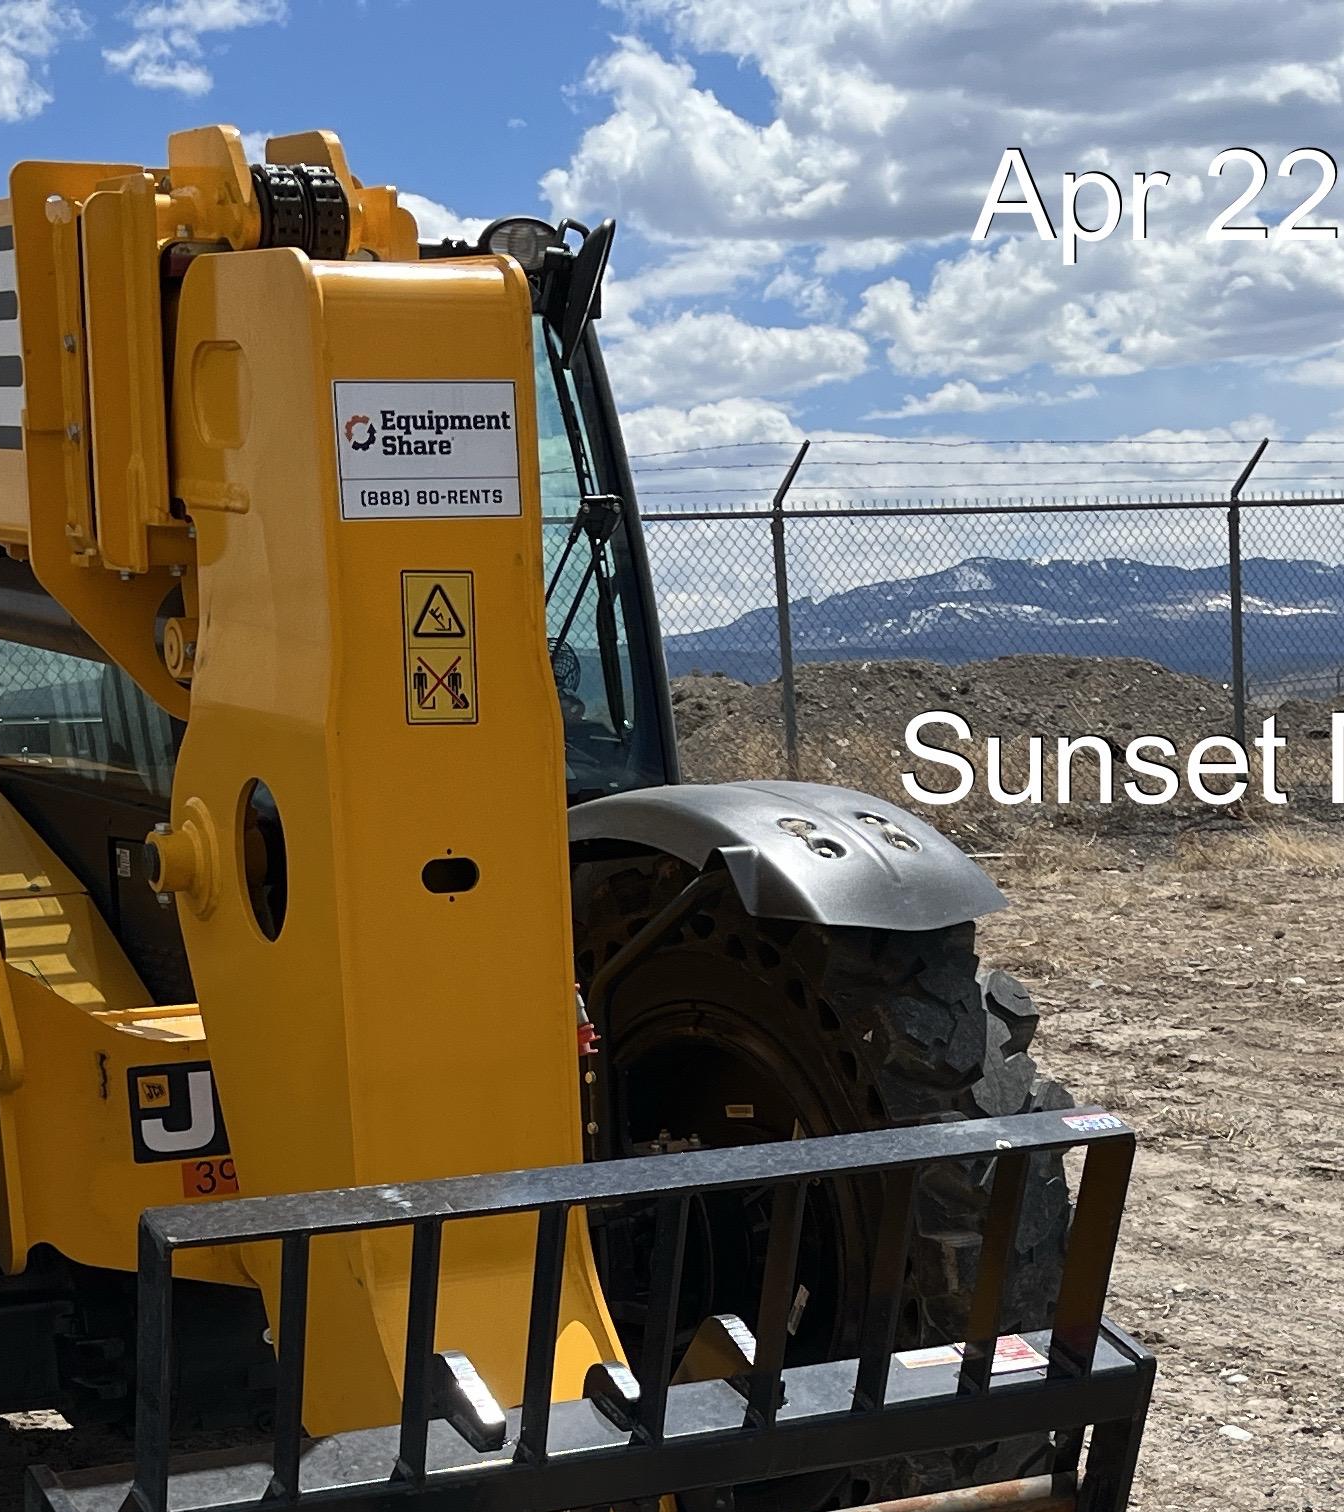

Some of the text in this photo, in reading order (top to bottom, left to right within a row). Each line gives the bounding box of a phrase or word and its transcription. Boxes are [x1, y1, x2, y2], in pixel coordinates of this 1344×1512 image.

[380, 410, 512, 435] Equipment
[381, 435, 453, 456] Share
[361, 489, 503, 507] (888) 80-RENTS
